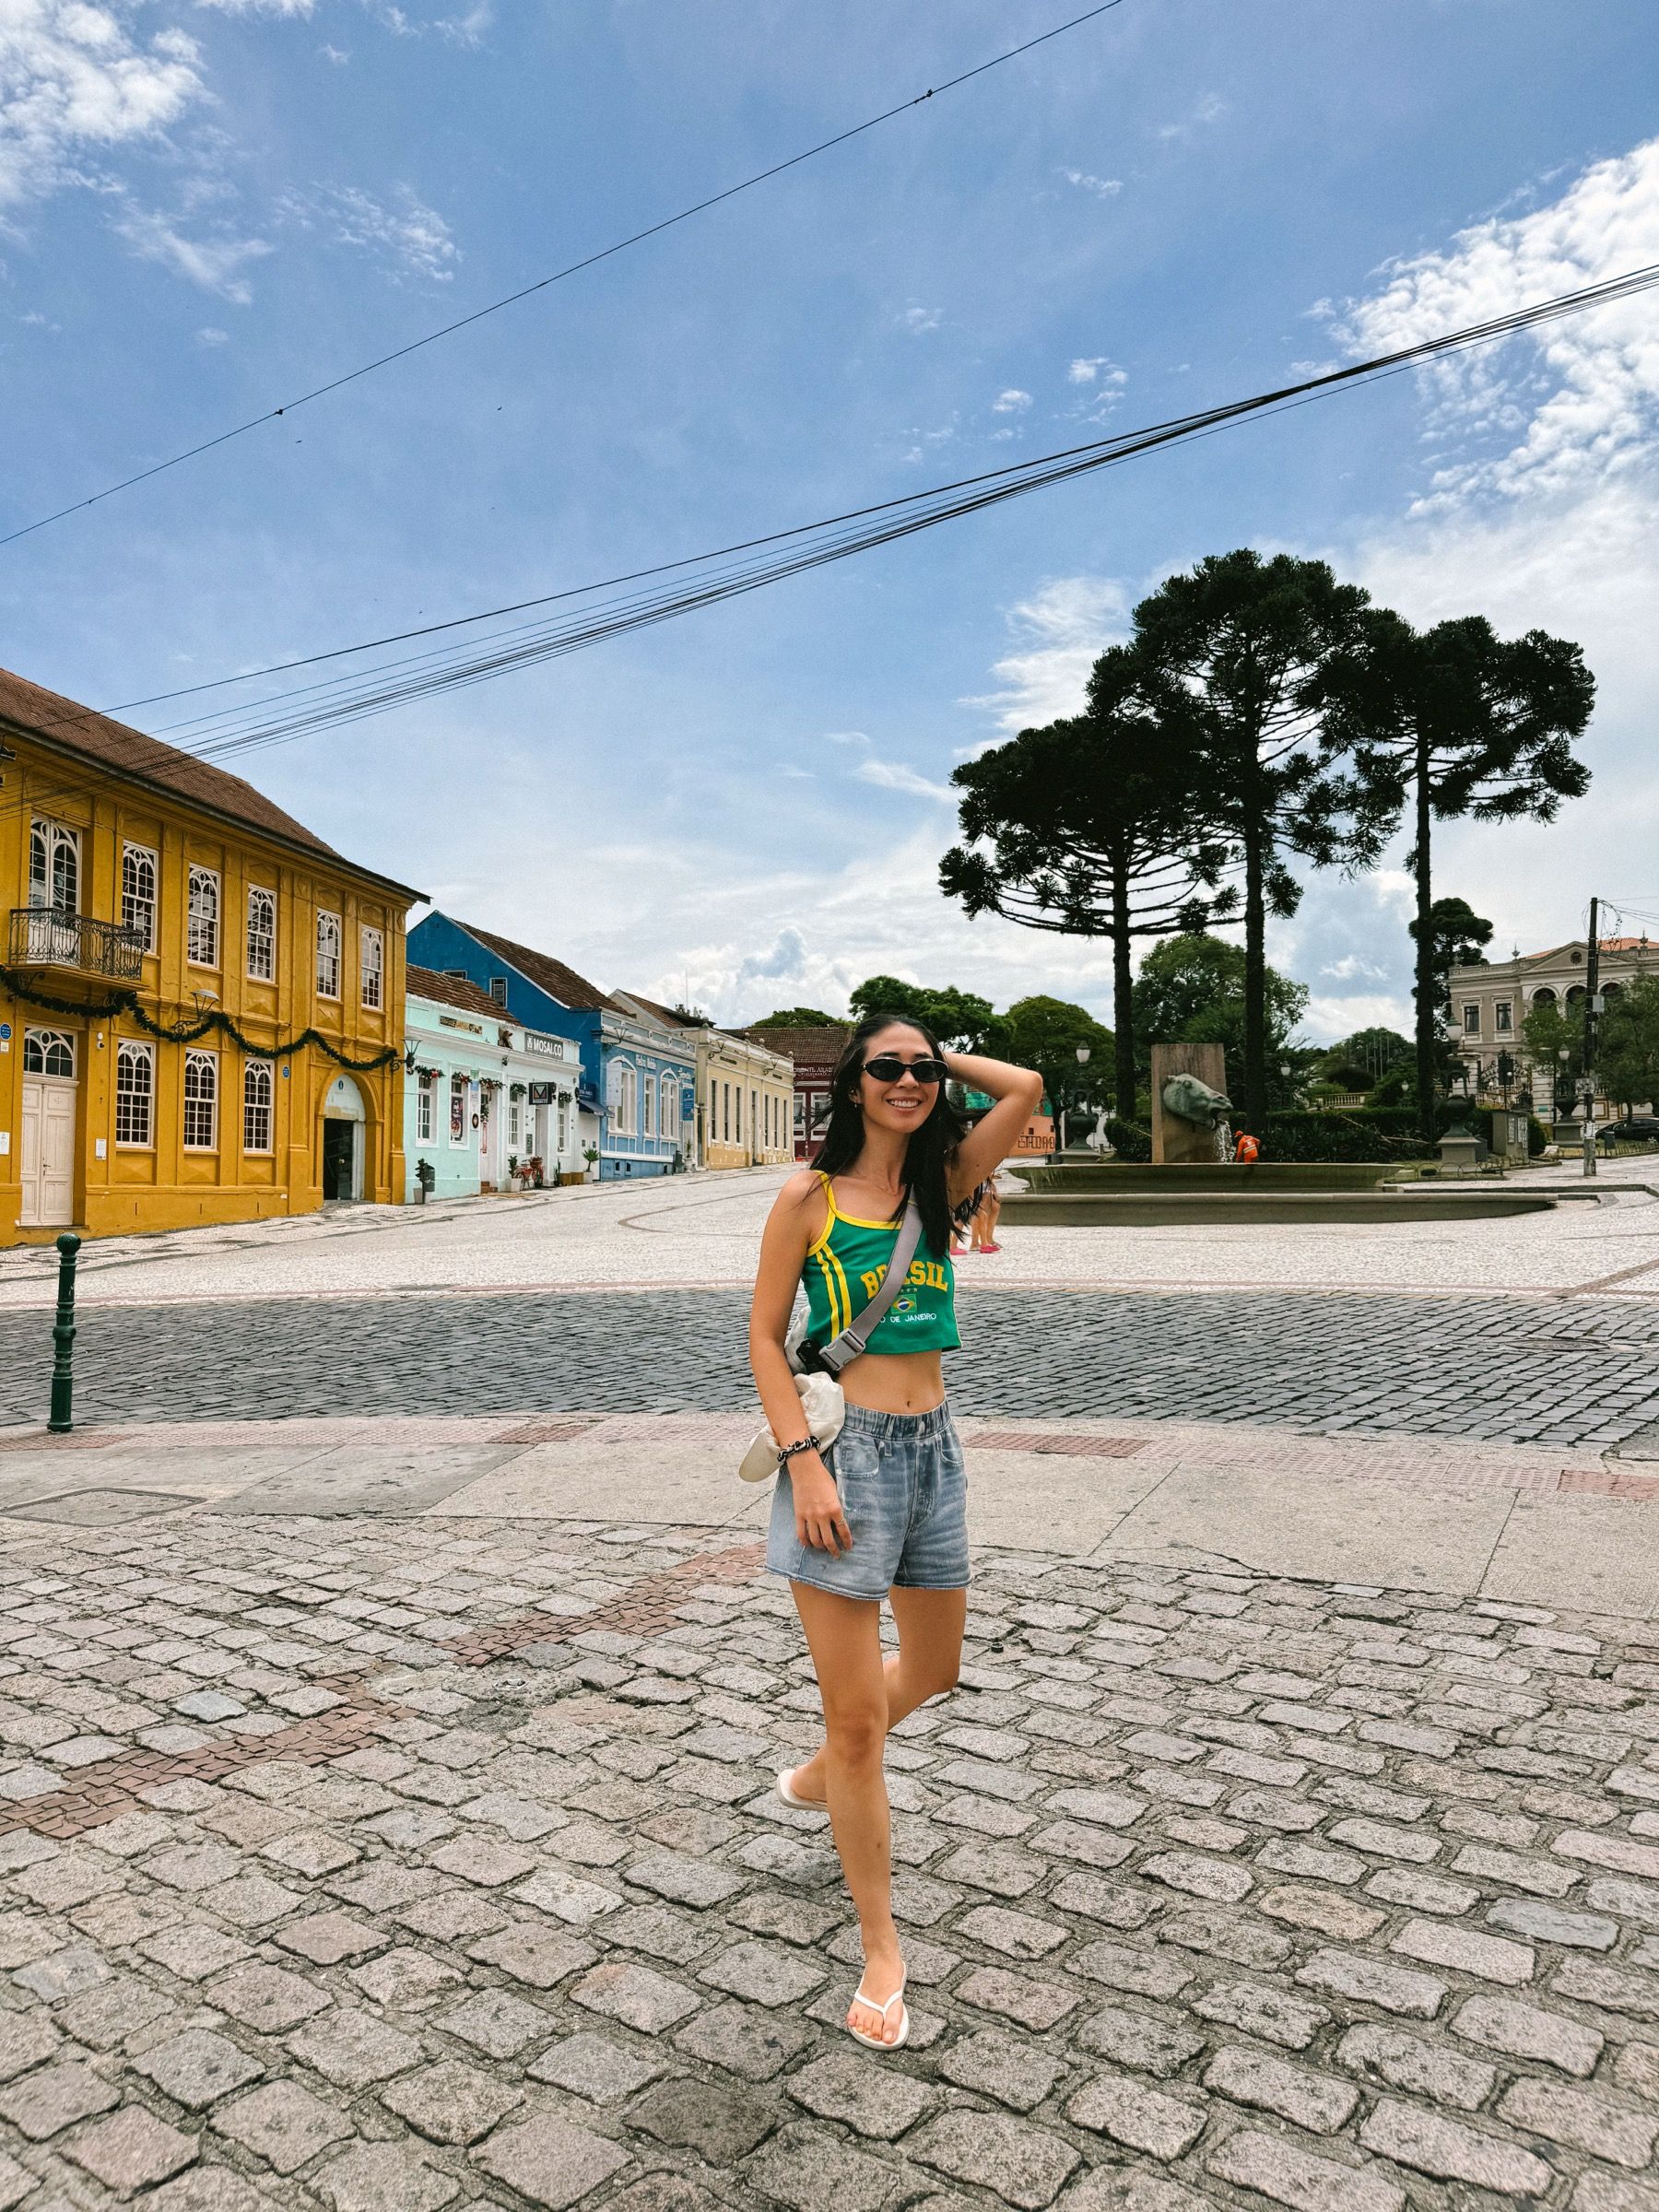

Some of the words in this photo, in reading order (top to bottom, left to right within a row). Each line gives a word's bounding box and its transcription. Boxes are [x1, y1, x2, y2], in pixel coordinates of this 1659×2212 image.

[860, 1260, 948, 1299] BSIL
[890, 1315, 900, 1324] DE
[905, 1312, 937, 1323] JANEIRO
